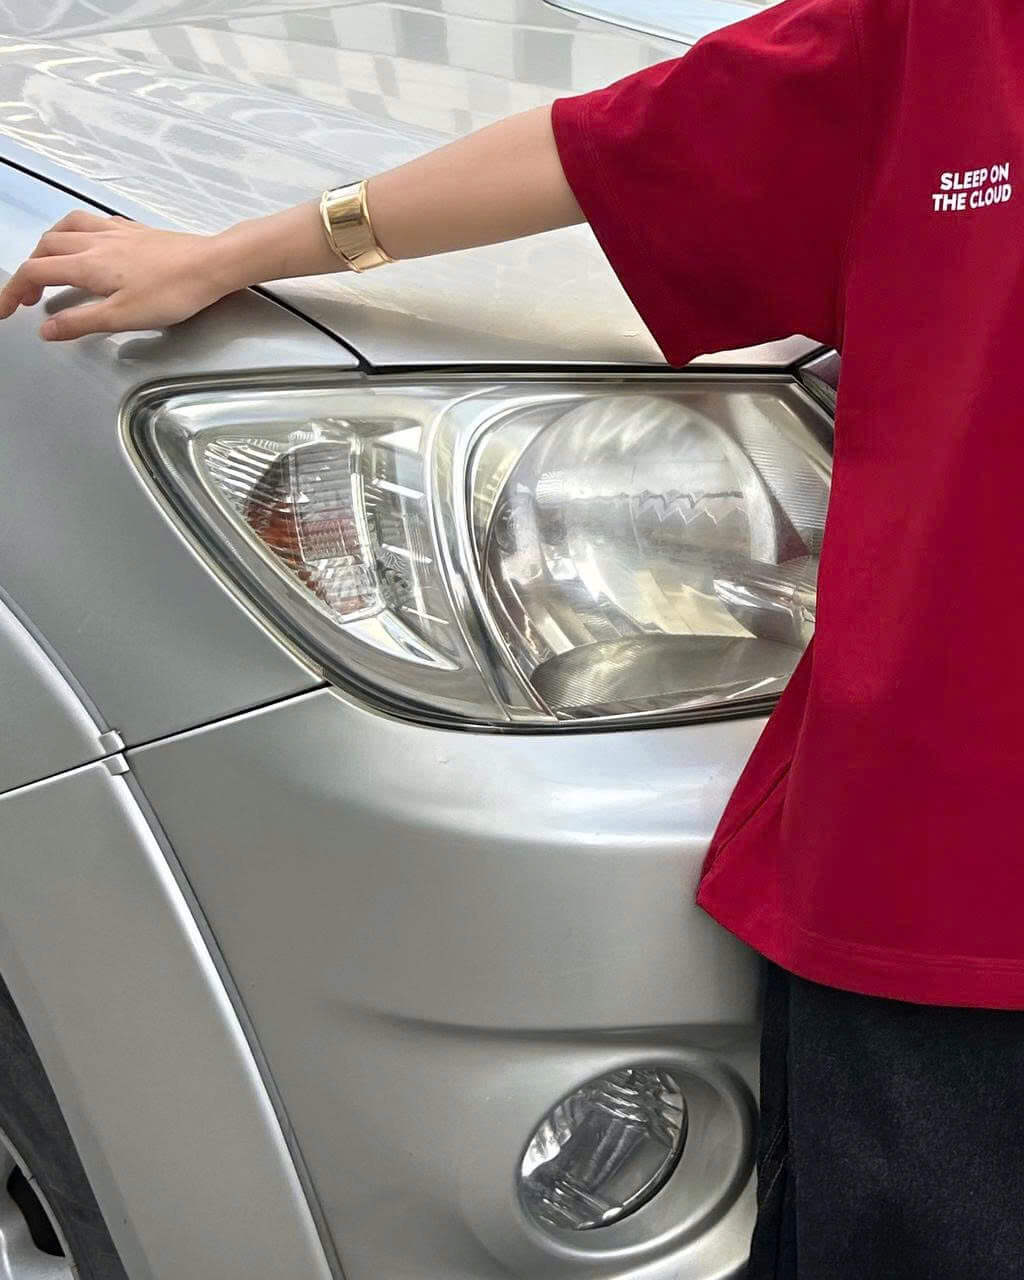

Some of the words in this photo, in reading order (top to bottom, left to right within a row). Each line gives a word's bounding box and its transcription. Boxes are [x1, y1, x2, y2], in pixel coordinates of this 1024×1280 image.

[940, 167, 989, 190] SLEEP
[990, 162, 1010, 184] ON
[932, 192, 967, 212] THE
[970, 183, 1012, 209] CLOUD
